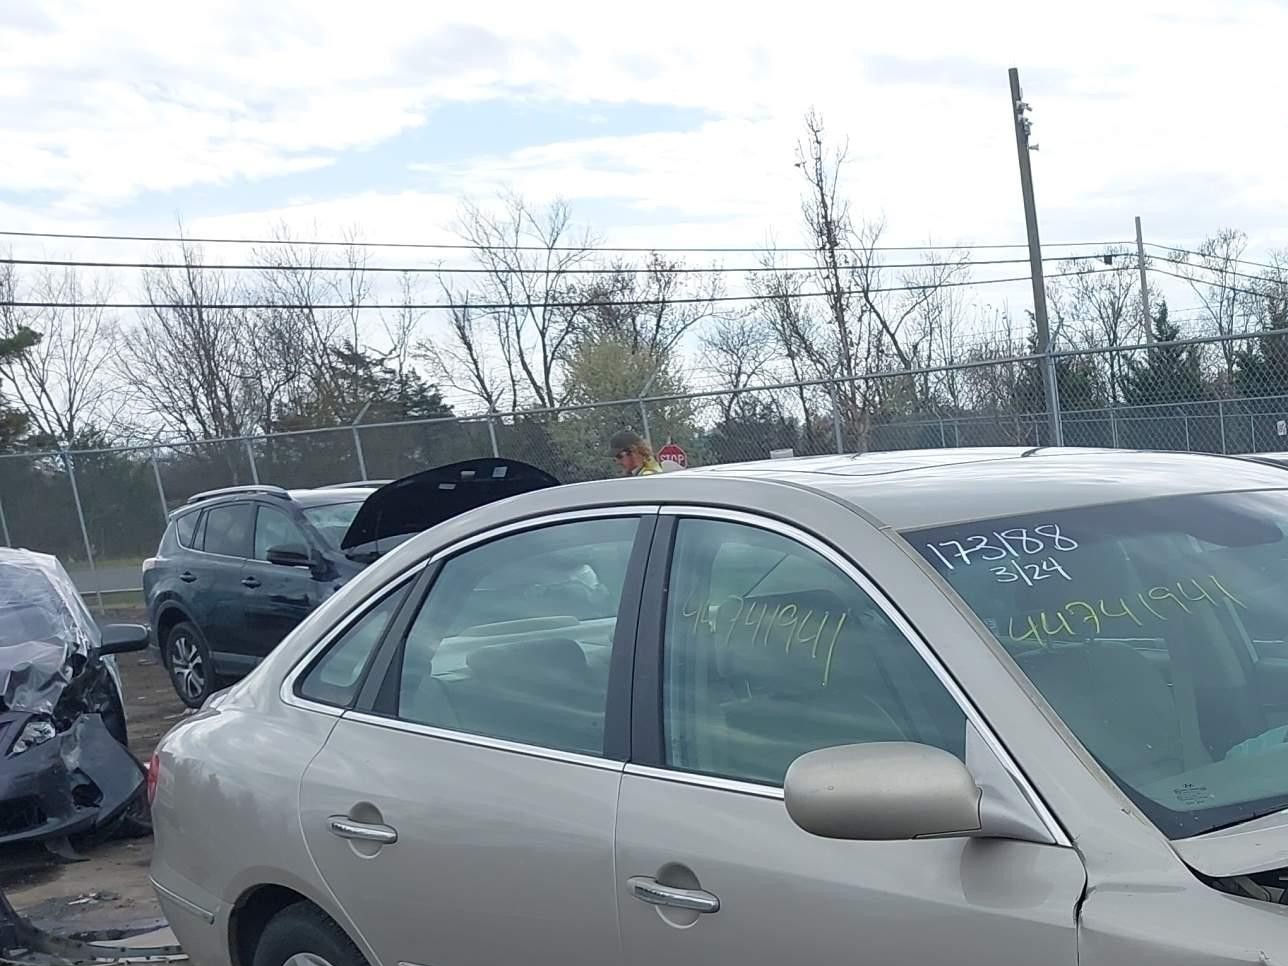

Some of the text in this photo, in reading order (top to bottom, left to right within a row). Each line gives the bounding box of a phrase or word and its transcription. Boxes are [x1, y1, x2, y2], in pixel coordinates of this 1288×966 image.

[927, 523, 1079, 570] 173188
[989, 556, 1073, 587] 3/24
[1008, 575, 1248, 648] 44741941
